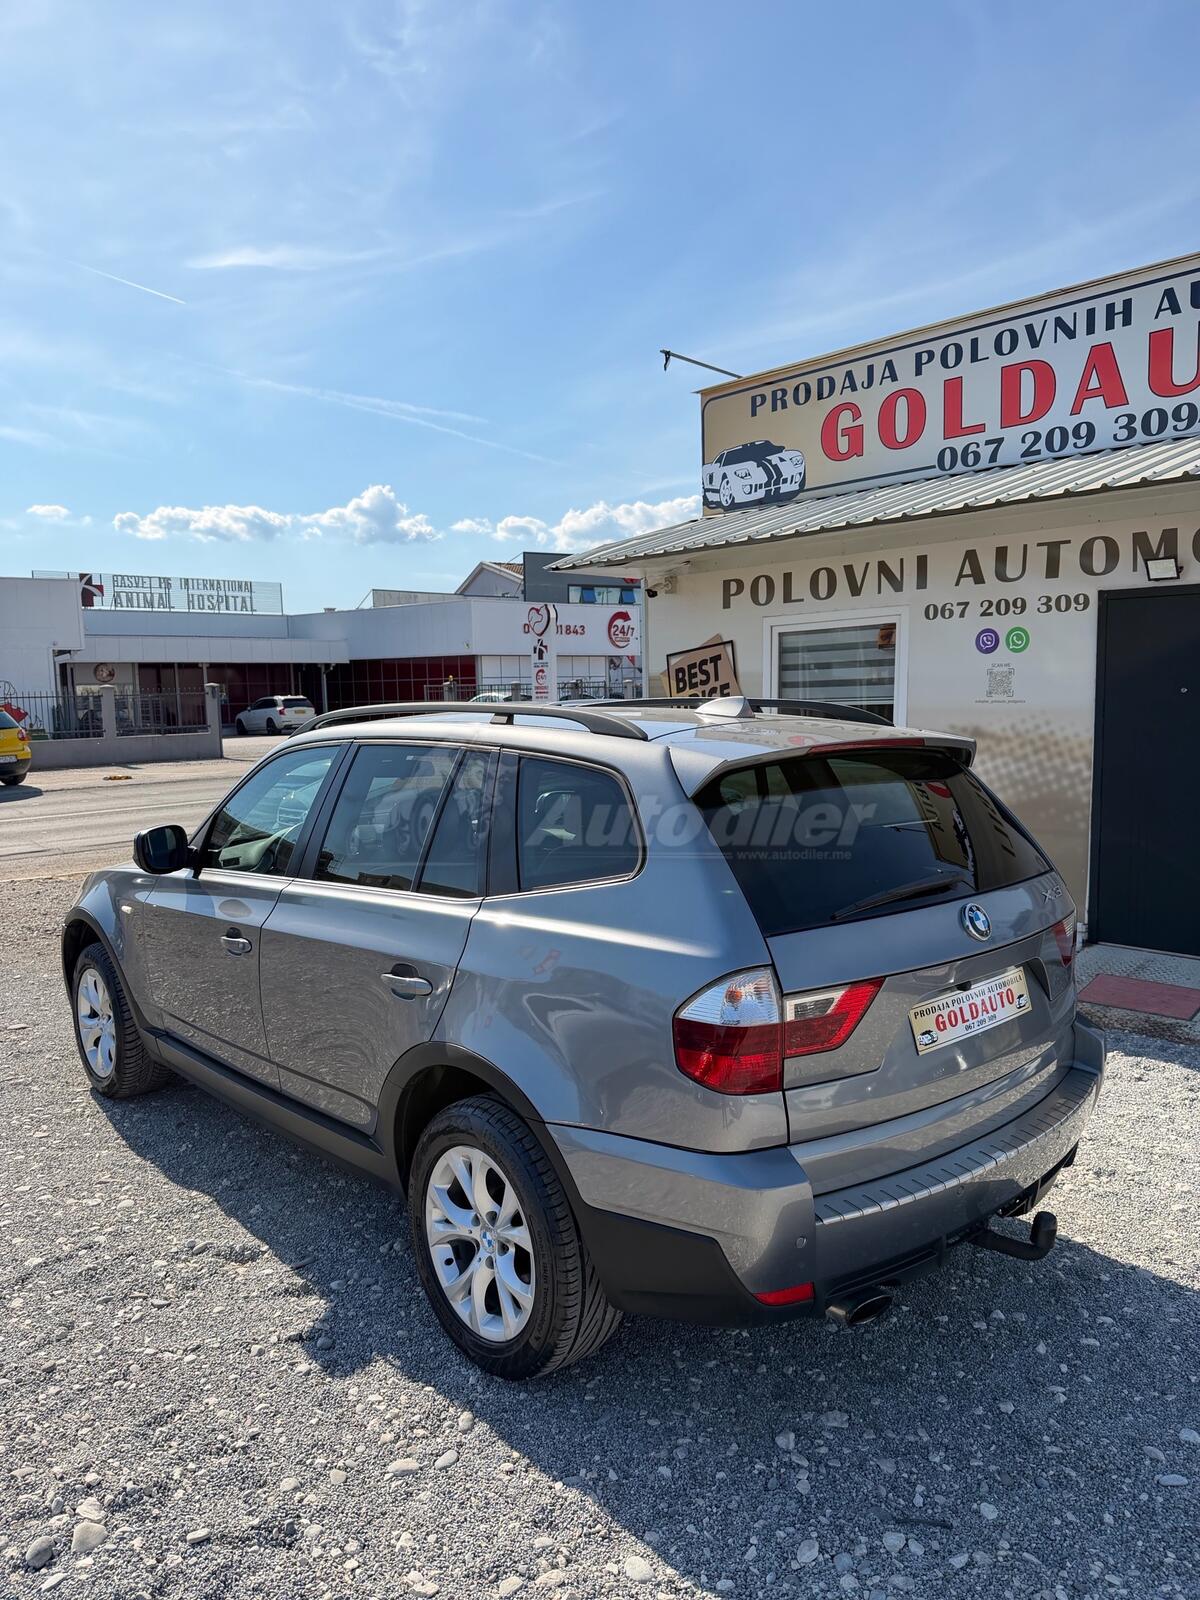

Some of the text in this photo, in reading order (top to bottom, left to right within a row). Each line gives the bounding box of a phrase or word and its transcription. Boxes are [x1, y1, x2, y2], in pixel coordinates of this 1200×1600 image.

[750, 359, 899, 418] PRODAJA
[914, 298, 1133, 377] POLOVNIH
[820, 321, 1200, 463] GOLDAU
[937, 402, 1199, 472] 067 209 309
[114, 591, 257, 612] ANIMAL HOSPITAL
[722, 554, 929, 610] POLOVNI
[923, 592, 1091, 621] 067 209 309
[612, 624, 635, 637] 24/7
[675, 653, 722, 694] BEST
[1042, 885, 1063, 905] X3
[914, 974, 1023, 1019] PRODAJA POLOVNIH AUTOMOBILA
[935, 988, 1015, 1032] GOLDAUTO
[964, 1020, 976, 1032] 067
[976, 1017, 987, 1028] 209
